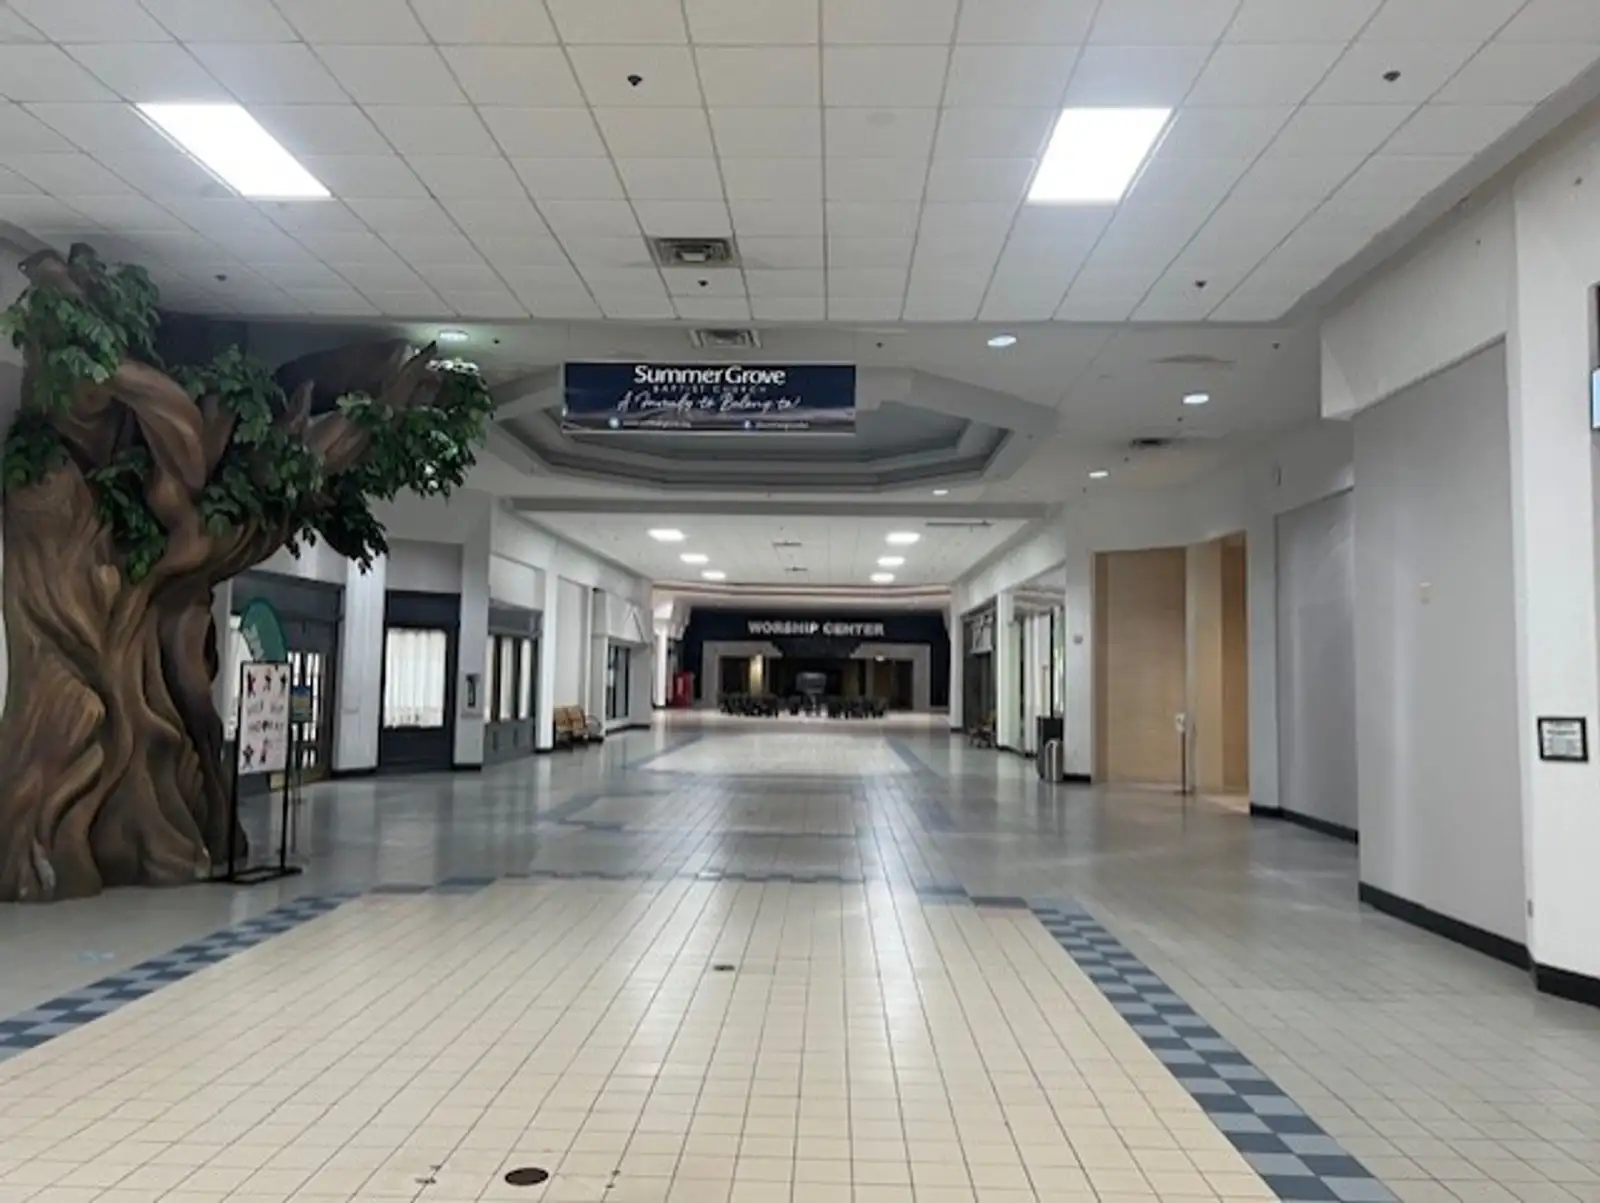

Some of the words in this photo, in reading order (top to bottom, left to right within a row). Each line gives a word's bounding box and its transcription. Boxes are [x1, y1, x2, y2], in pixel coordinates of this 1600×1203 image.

[634, 364, 723, 384] Summer
[725, 364, 786, 385] Grove
[747, 620, 820, 635] WORSHIP
[822, 622, 885, 636] CENTER
